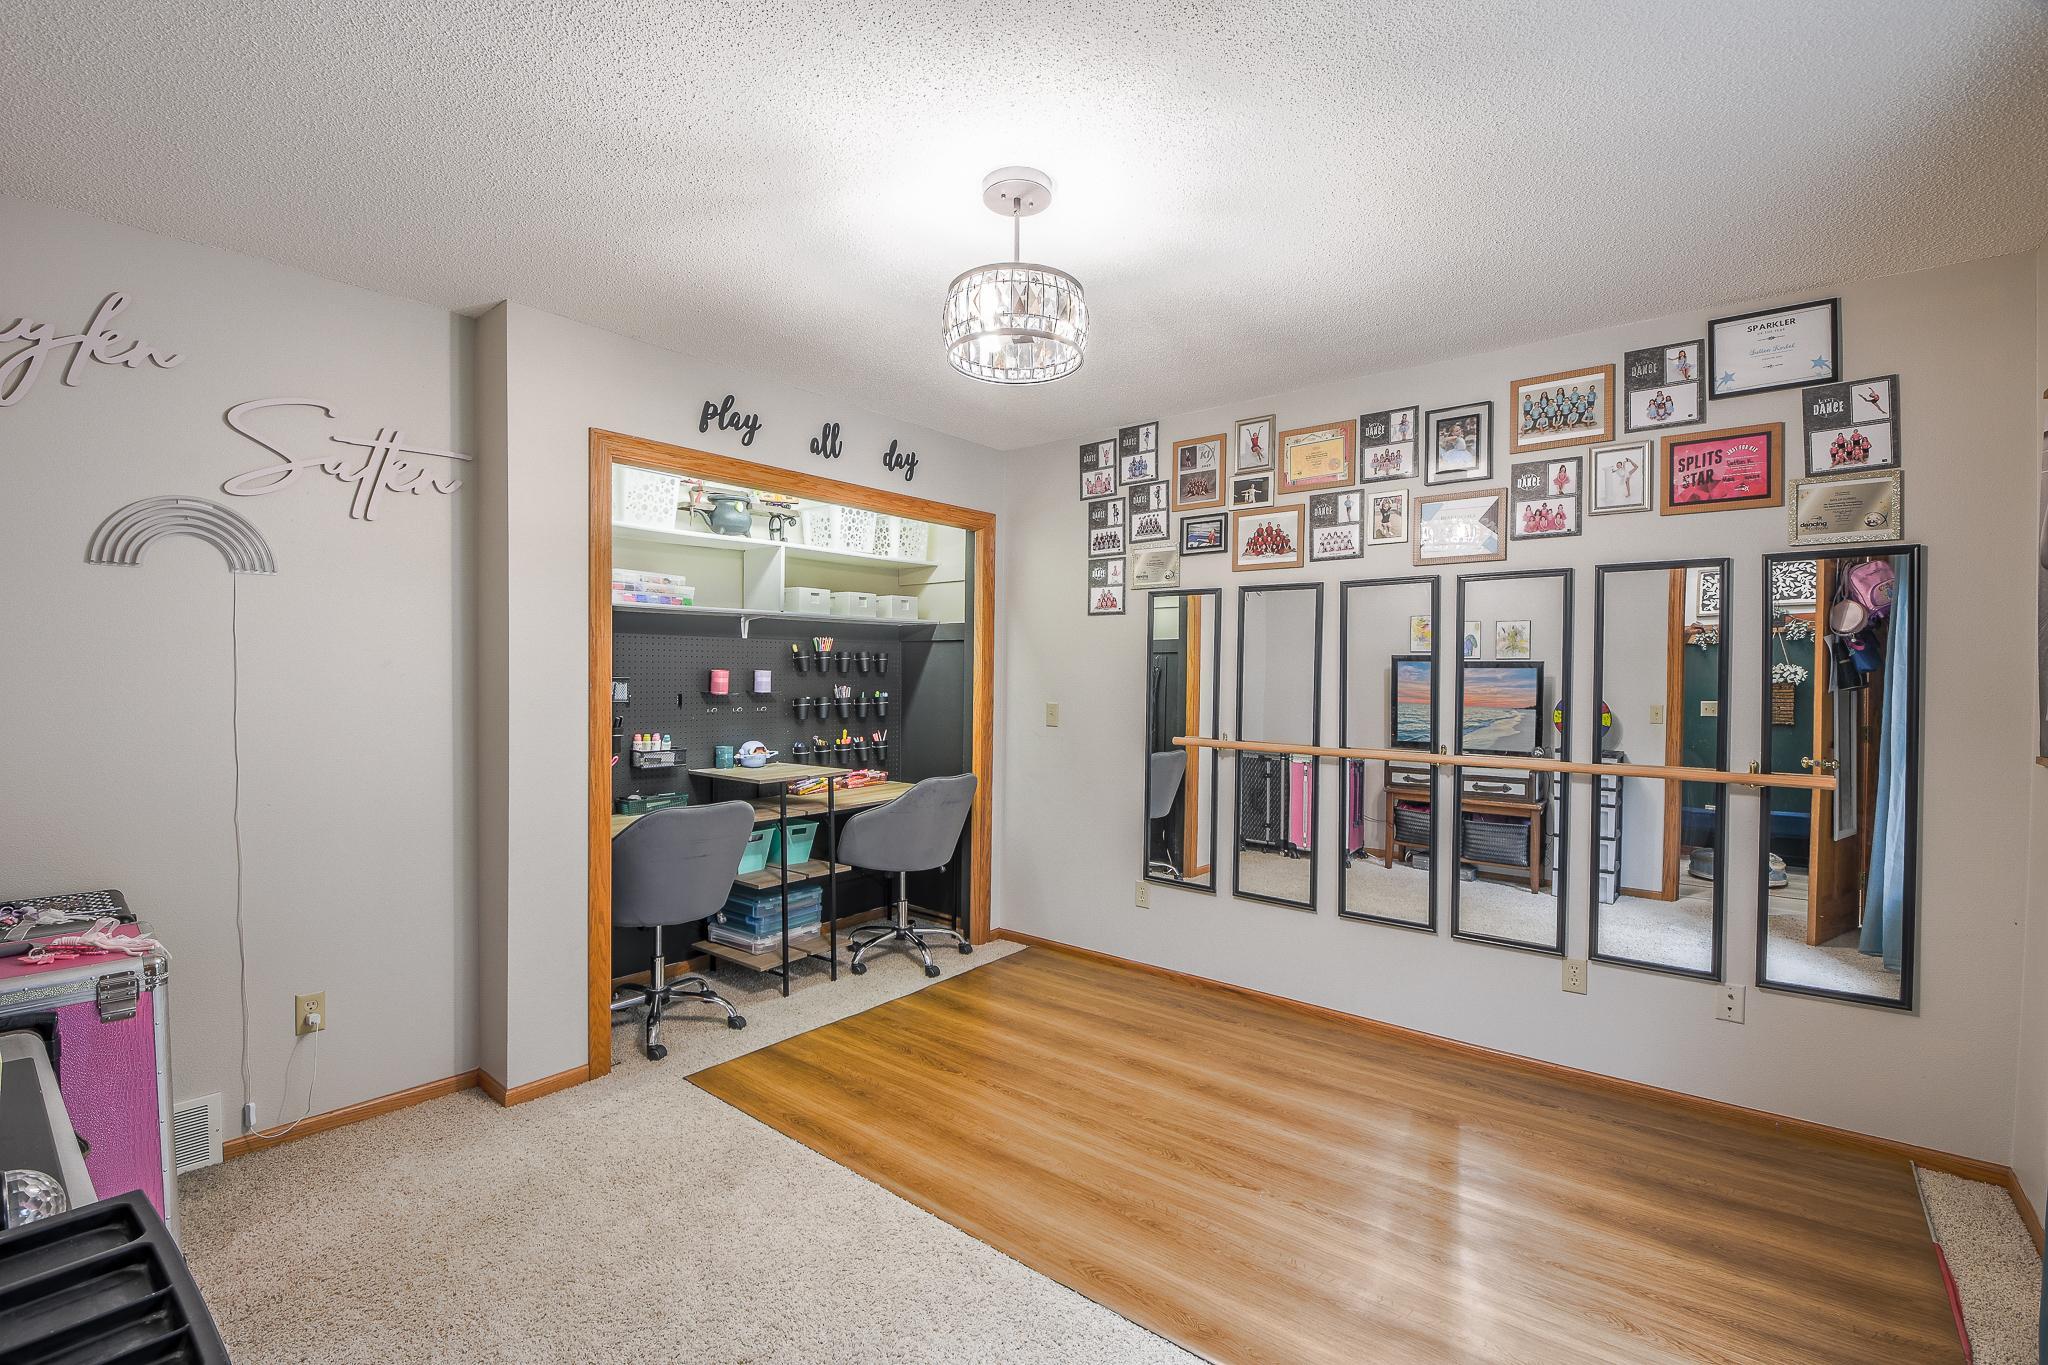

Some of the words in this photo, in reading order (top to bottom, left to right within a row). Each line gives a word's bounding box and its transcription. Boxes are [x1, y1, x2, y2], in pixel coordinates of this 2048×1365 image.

[1747, 317, 1796, 333] SPARKLER
[1631, 362, 1657, 377] DANCE
[1813, 400, 1844, 416] DANCE
[699, 394, 762, 446] play
[810, 422, 842, 459] all
[883, 439, 919, 481] day
[1365, 425, 1385, 436] DANCE
[1678, 449, 1723, 473] SPLITS
[1517, 476, 1541, 489] DANCE
[1682, 469, 1714, 489] STAR
[1800, 521, 1828, 529] dancing
